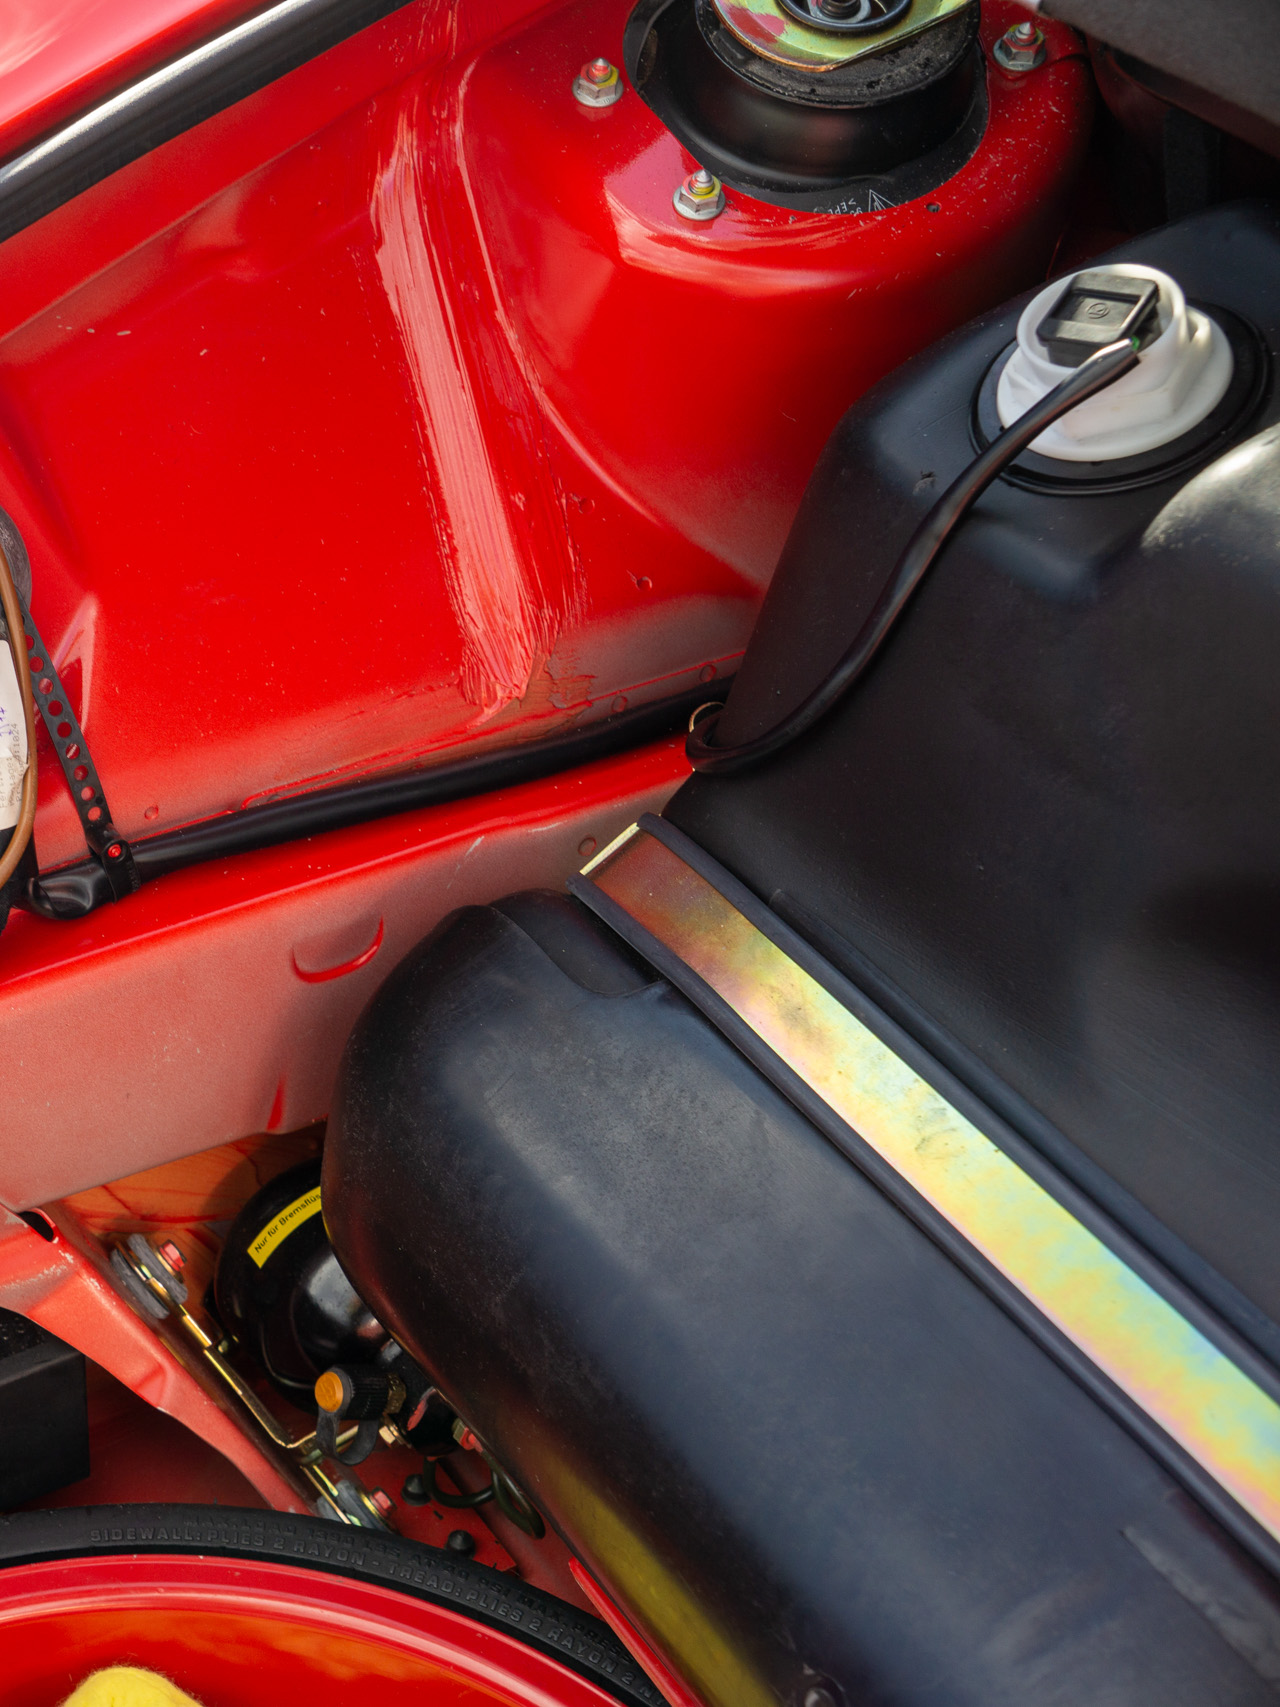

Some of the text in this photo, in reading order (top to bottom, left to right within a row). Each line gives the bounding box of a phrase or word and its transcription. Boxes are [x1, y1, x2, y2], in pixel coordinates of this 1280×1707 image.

[254, 1236, 268, 1254] Nur
[267, 1223, 280, 1238] für
[90, 1526, 201, 1543] SIDEWALL:
[207, 1528, 265, 1546] PLIES
[273, 1537, 285, 1550] 2
[293, 1540, 366, 1567] RAYON
[388, 1562, 462, 1597] TREAD:
[465, 1589, 523, 1623] PLIES
[528, 1618, 544, 1632] 2
[547, 1626, 618, 1674] RAYON
[621, 1671, 636, 1686] 2
